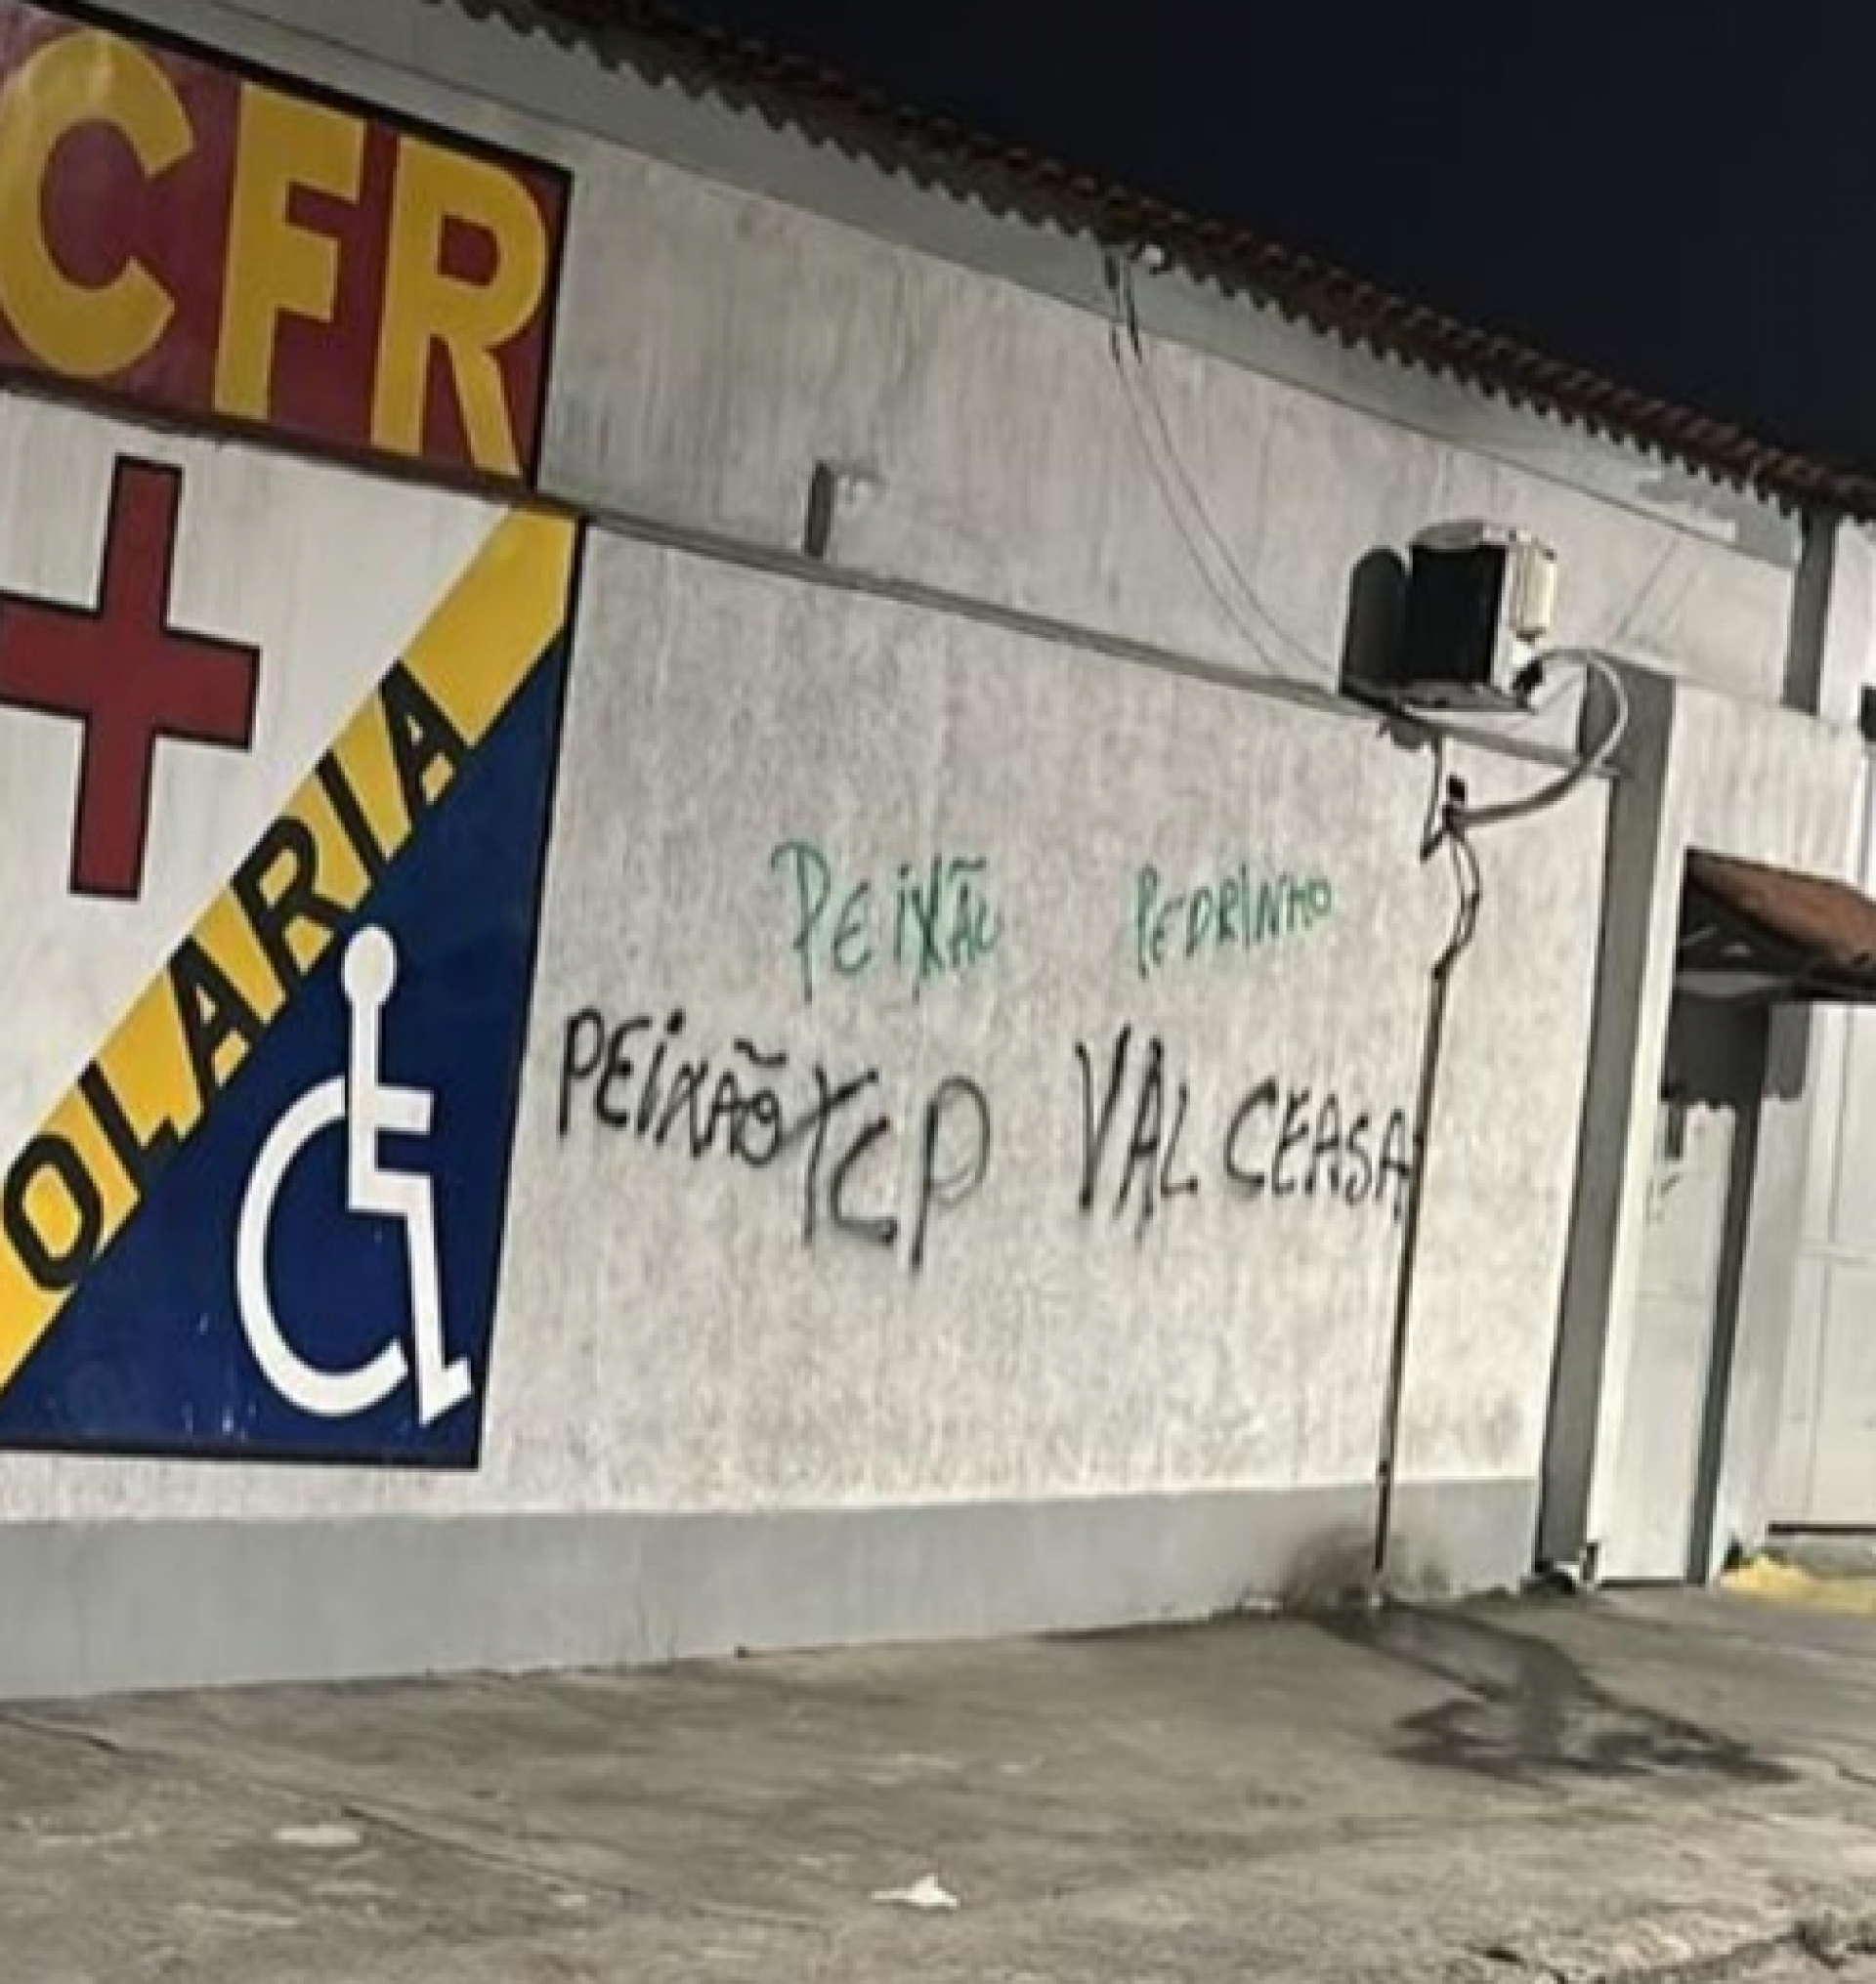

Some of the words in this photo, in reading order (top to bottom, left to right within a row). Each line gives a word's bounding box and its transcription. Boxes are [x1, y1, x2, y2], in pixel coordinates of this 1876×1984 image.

[0, 27, 548, 477] CFR
[1, 660, 469, 1291] OLARIA
[1075, 1023, 1199, 1245] VAL
[1224, 1075, 1416, 1223] CEASA
